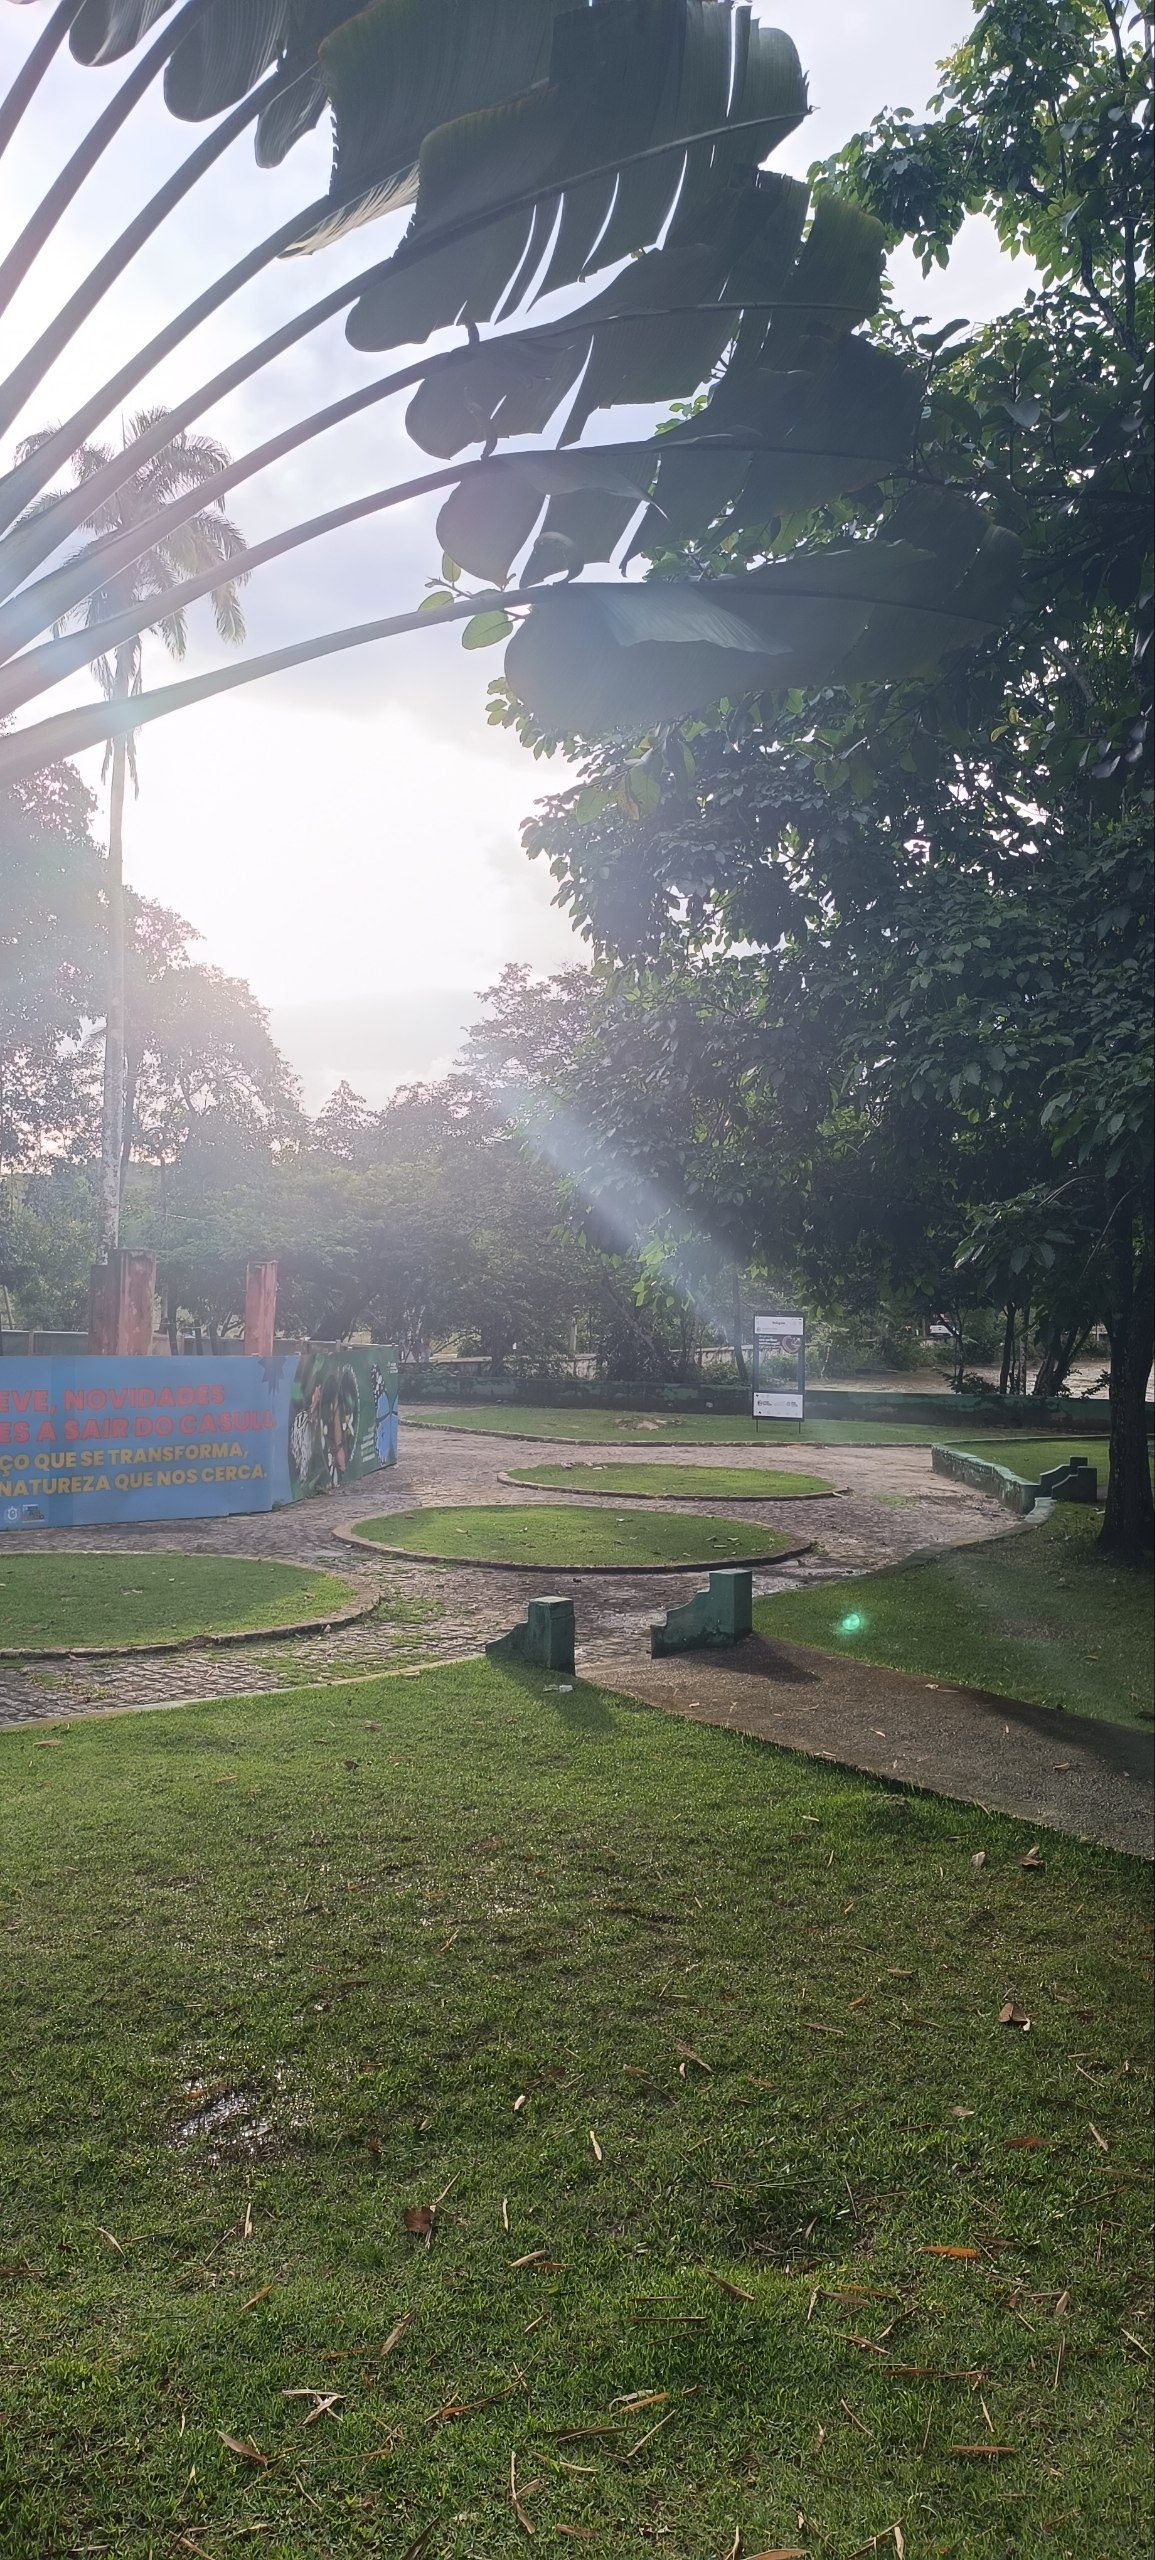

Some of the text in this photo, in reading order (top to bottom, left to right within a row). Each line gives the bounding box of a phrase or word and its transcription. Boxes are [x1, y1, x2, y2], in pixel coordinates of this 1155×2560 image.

[64, 1384, 225, 1411] NOVIDADES
[37, 1420, 56, 1443] A
[64, 1417, 129, 1441] SAIR
[135, 1415, 174, 1437] DO
[34, 1452, 77, 1472] QUE
[80, 1450, 104, 1467] SE
[108, 1441, 248, 1465] TRANSFORMA,
[0, 1464, 268, 1497] NATUREZA QUE NOS CERCA.
